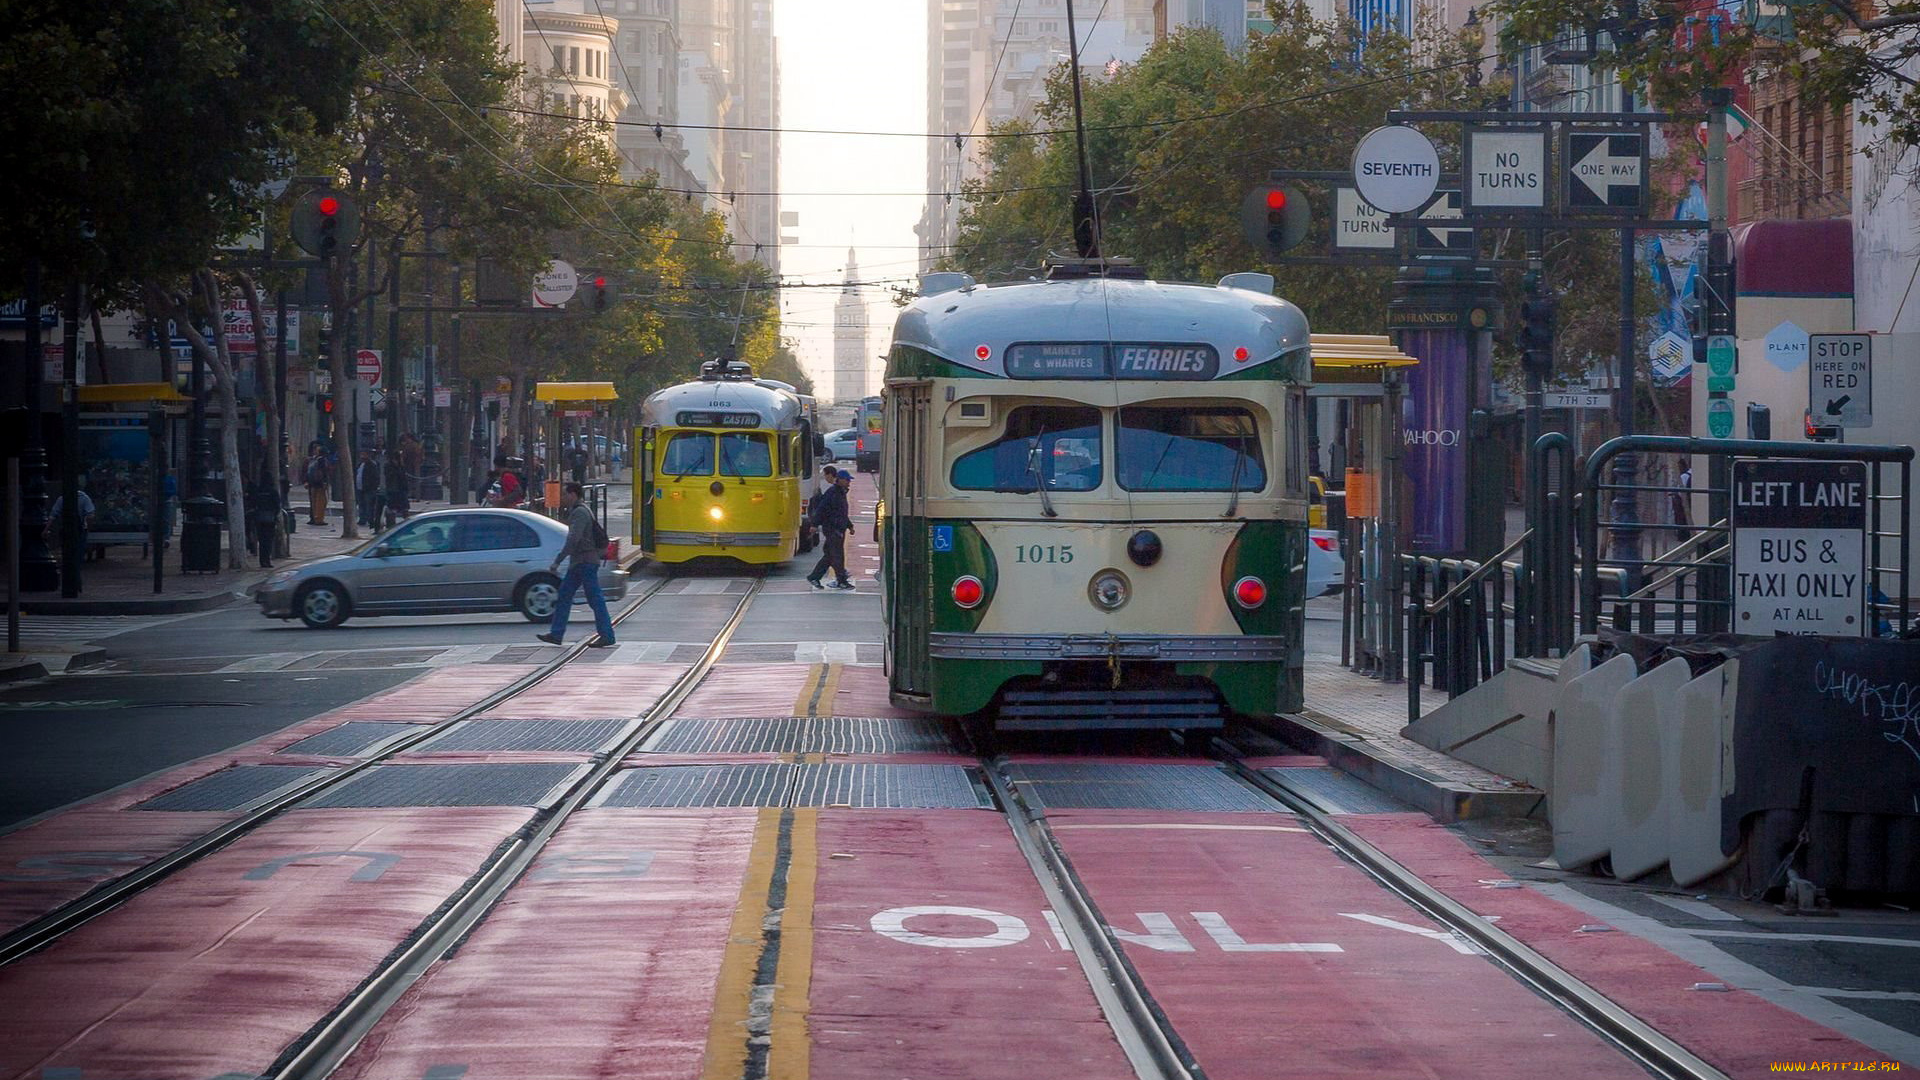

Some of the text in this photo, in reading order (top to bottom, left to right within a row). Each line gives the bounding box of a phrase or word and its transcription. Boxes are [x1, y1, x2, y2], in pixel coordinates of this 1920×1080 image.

[1496, 152, 1519, 168] NO
[1362, 162, 1432, 177] SEVENTH
[1581, 164, 1636, 176] ONE WAY
[1478, 172, 1537, 189] TURNS
[1356, 204, 1376, 217] NO
[1342, 220, 1390, 233] TURNS
[1042, 346, 1081, 356] MARKET
[1768, 343, 1806, 351] PLANT
[1817, 341, 1863, 357] STOP
[1033, 358, 1093, 369] & WHARVES
[1120, 347, 1207, 372] FERRIES
[1815, 362, 1866, 371] HERE ON
[1823, 374, 1858, 388] RED
[708, 400, 732, 408] 1063
[1557, 395, 1599, 405] 7TH ST
[722, 415, 758, 425] CASTRO
[1714, 425, 1730, 436] 20
[1402, 428, 1461, 447] YAHOO!
[1737, 481, 1861, 507] LEFT LANE
[1015, 544, 1074, 564] 1015
[1760, 538, 1838, 564] BUS &
[1737, 573, 1857, 598] TAXI ONLY
[1773, 608, 1824, 621] AT ALL
[869, 905, 1501, 957] ONLY
